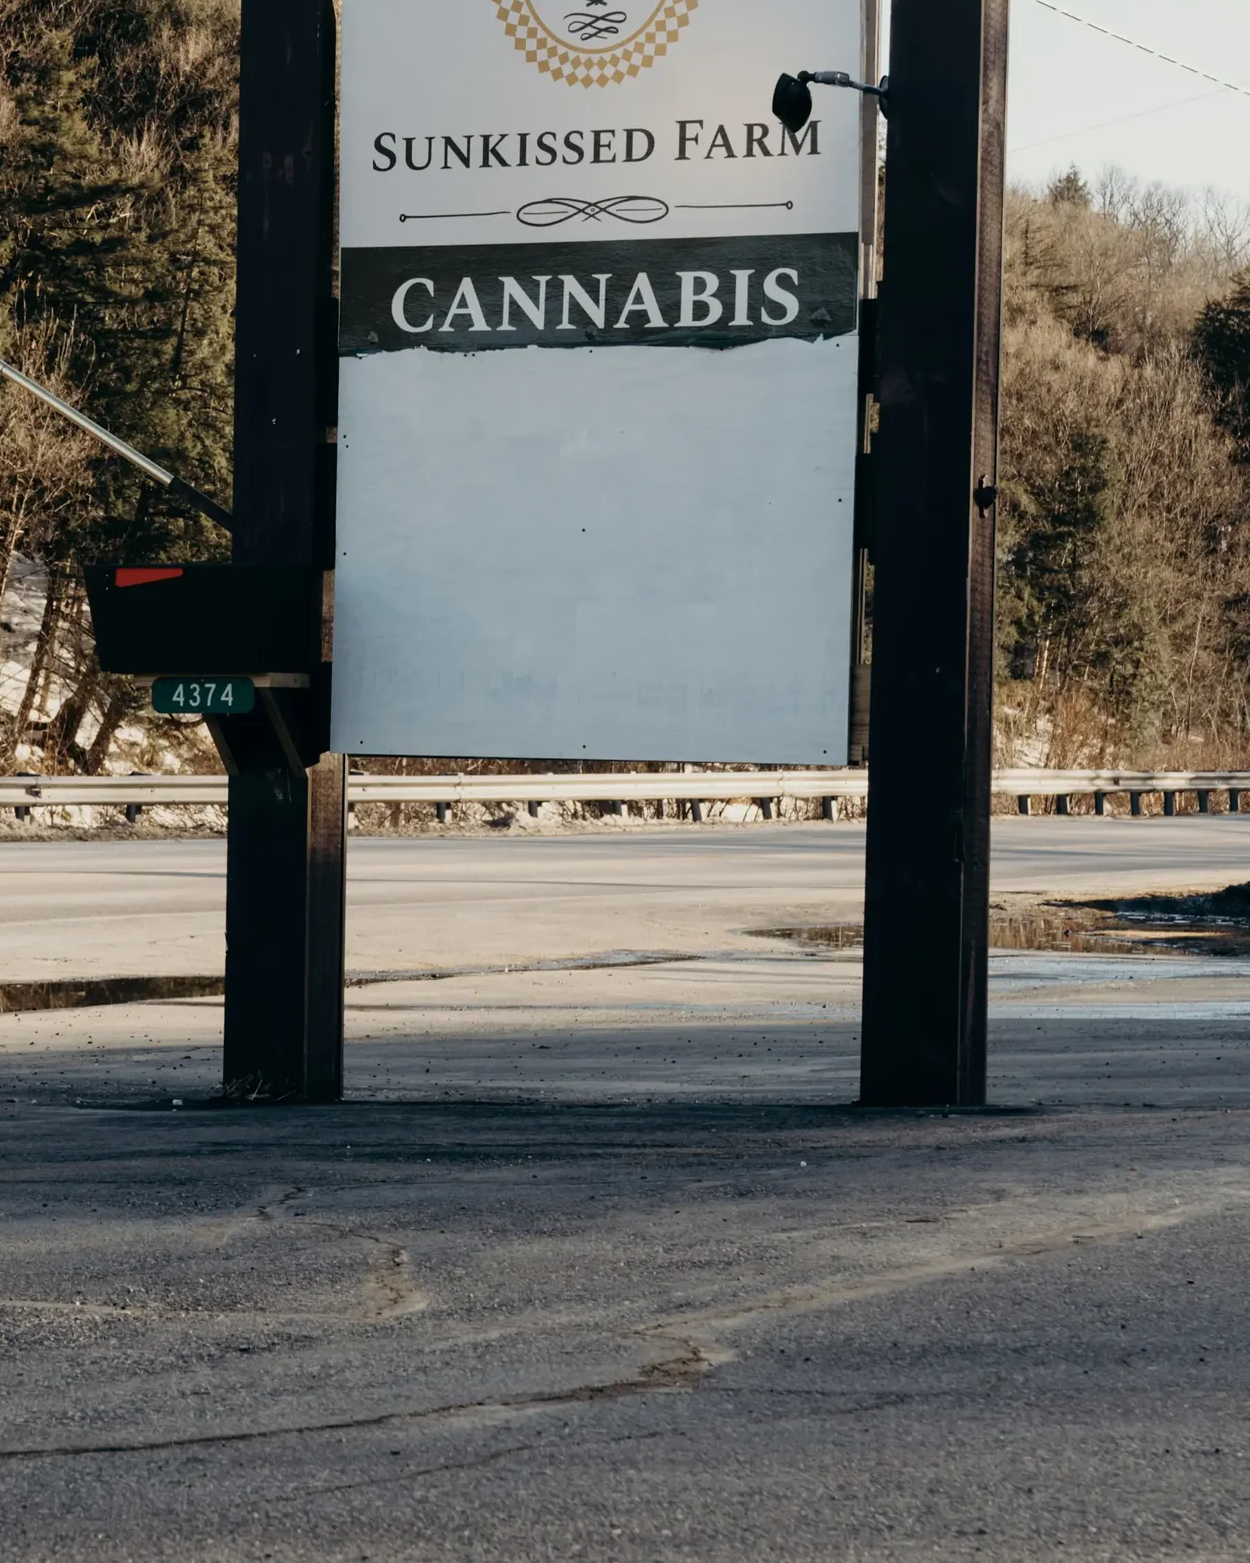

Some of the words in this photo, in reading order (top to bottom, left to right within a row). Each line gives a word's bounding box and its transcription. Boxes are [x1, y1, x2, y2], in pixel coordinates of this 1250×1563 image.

[372, 128, 655, 171] SUNKISSED
[674, 119, 822, 161] FARM
[391, 267, 801, 333] CANNABIS
[172, 683, 234, 707] 4374
